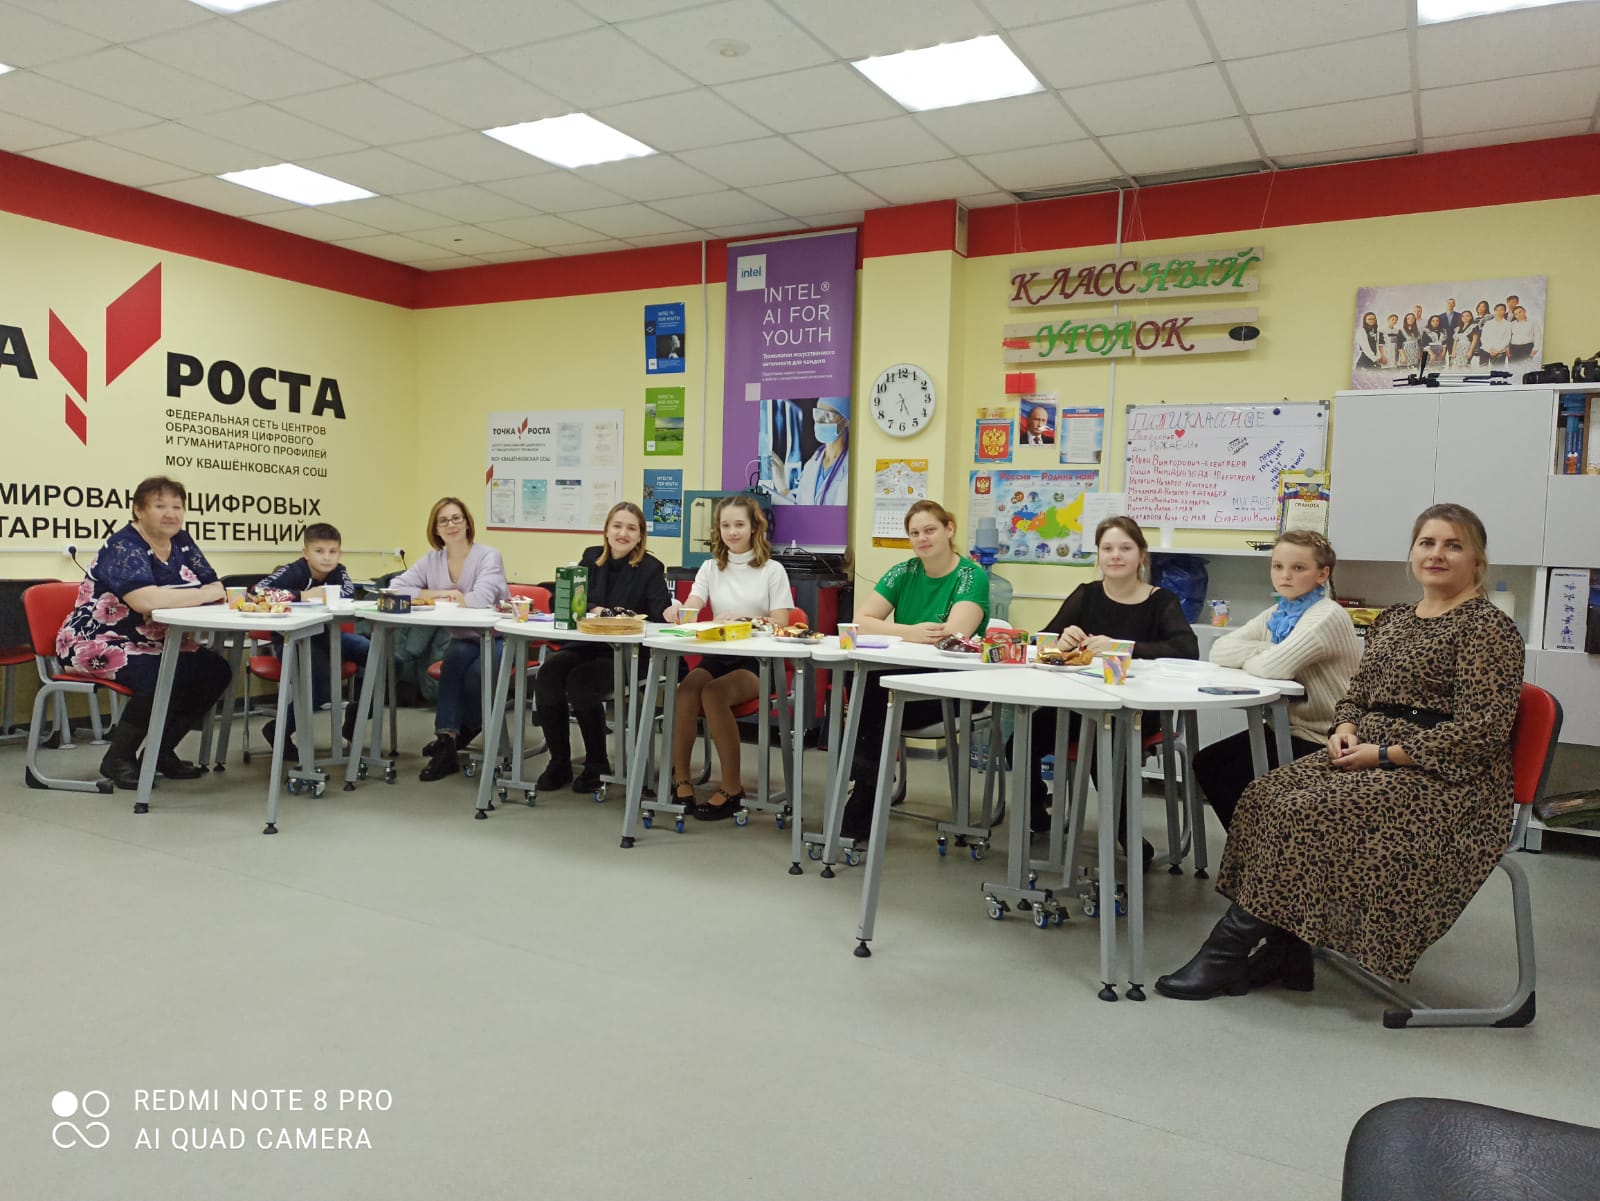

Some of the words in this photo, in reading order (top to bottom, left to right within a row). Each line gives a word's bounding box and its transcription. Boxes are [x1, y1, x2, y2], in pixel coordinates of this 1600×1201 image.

[741, 266, 762, 279] intel
[1011, 248, 1261, 305] КЛАССНЫЙ
[763, 308, 781, 325] AI
[790, 304, 830, 323] FOR
[762, 326, 832, 347] YOUTH
[1036, 317, 1195, 358] УГОЛОК
[0, 324, 38, 380] А
[166, 352, 346, 420] РОСТА
[898, 368, 908, 379] 12
[913, 371, 916, 381] 1
[886, 373, 895, 383] 11
[877, 383, 887, 394] 10
[921, 380, 928, 390] 2
[874, 397, 880, 407] 9
[924, 394, 931, 403] 3
[878, 410, 884, 420] 8
[922, 408, 927, 417] 4
[165, 408, 249, 426] ФЕДЕРАЛЬНАЯ
[252, 418, 279, 430] СЕТЬ
[281, 422, 327, 436] ЦЕНТРОВ
[888, 419, 894, 429] 7
[899, 422, 905, 431] 6
[912, 418, 918, 427] 5
[165, 421, 249, 439] ОБРАЗОВАНИЯ
[251, 431, 314, 446] ЦИФРОВОГО
[492, 427, 516, 436] ТОЧКА
[527, 427, 551, 435] РОСТА
[165, 436, 174, 445] И
[177, 436, 271, 454] ГУМАНИТАРНОГО
[273, 445, 327, 459] ПРОФИЛЕЙ
[165, 455, 193, 467] МОУ
[196, 457, 300, 476] КВАШЁНКОВСКАЯ
[302, 466, 328, 478] СОШ
[0, 483, 134, 509] МИРОВАН
[188, 492, 321, 516] ЦИФРОВЫХ
